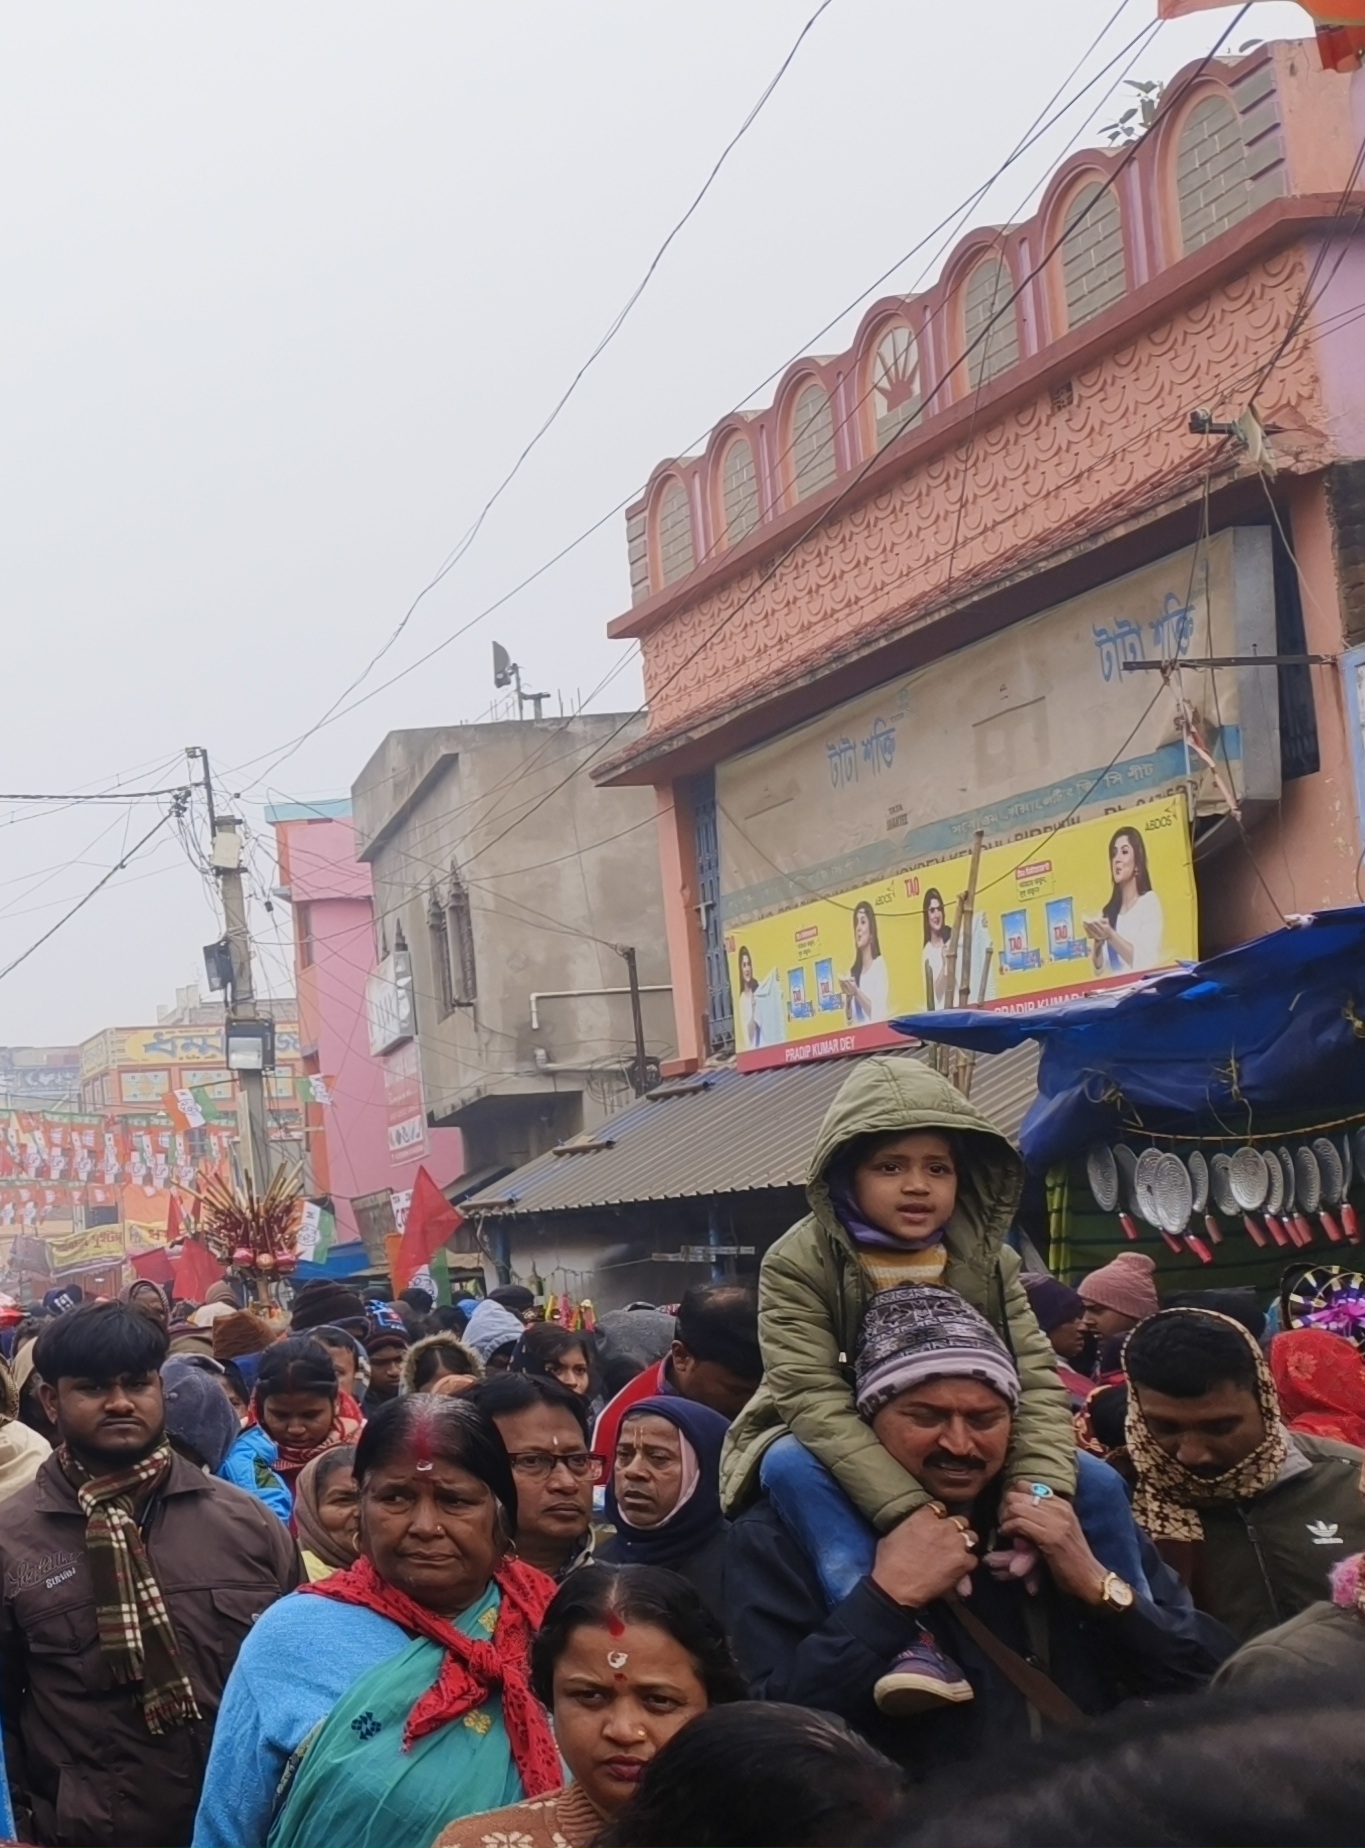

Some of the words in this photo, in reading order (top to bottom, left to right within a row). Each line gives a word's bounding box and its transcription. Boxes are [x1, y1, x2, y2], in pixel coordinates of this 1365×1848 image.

[826, 733, 859, 788] টাটা
[1144, 815, 1173, 833] ABDOS
[904, 876, 921, 899] TAO
[785, 1043, 811, 1062] PRADIP
[812, 1039, 840, 1056] KUMAR
[840, 1035, 856, 1050] DEY
